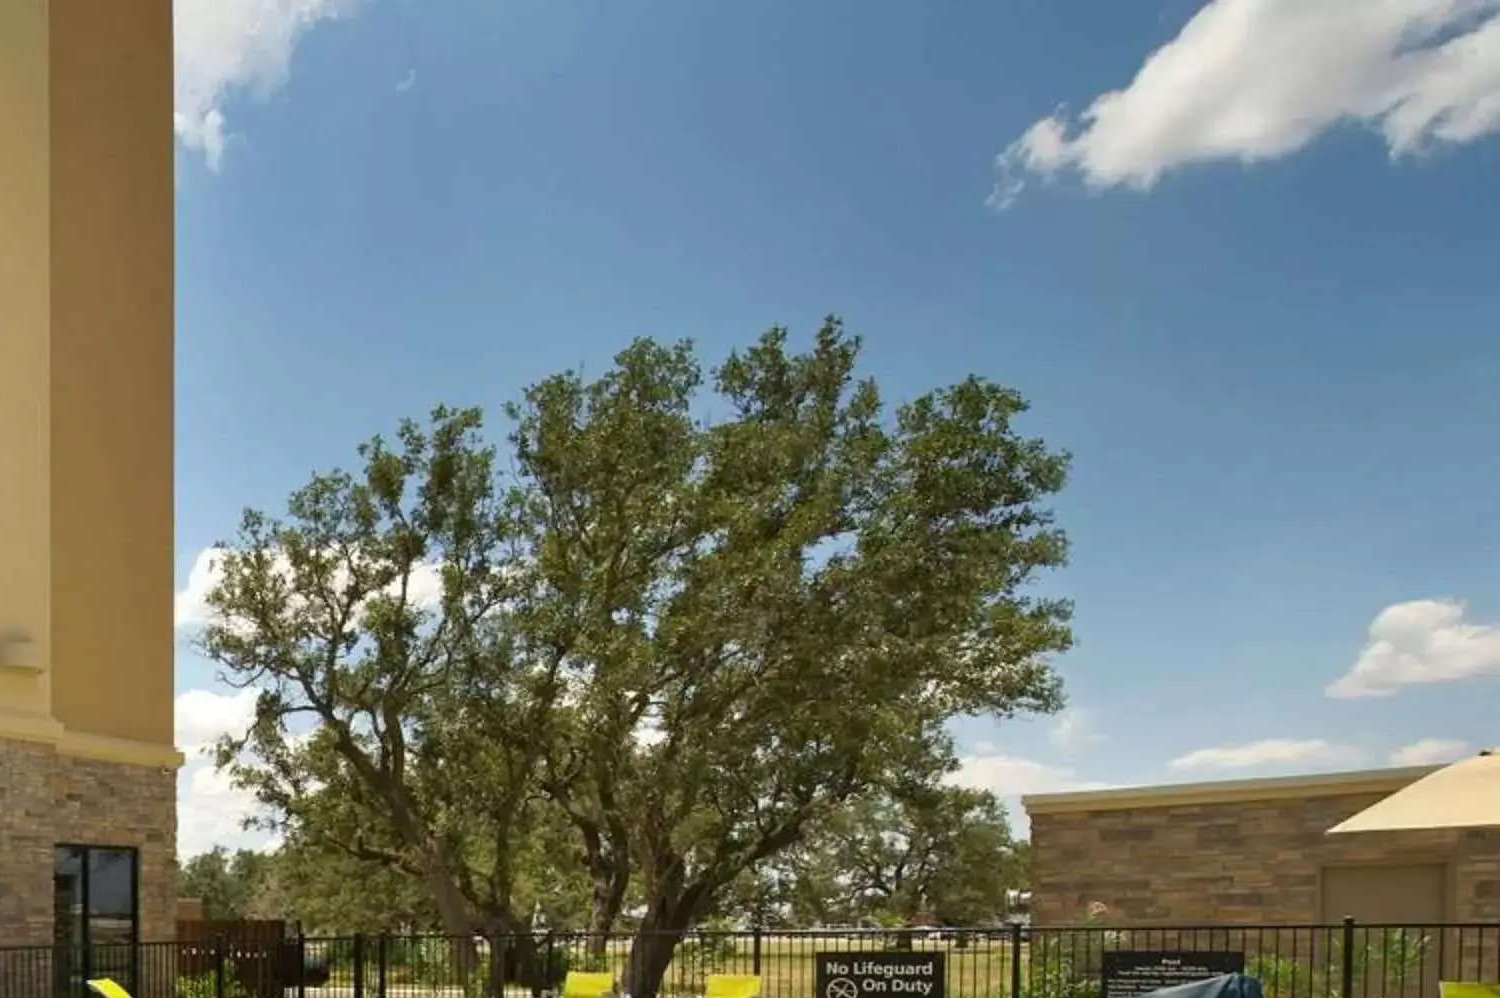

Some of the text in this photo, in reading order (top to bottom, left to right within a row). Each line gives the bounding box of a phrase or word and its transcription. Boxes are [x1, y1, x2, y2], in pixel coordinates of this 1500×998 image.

[826, 961, 933, 978] No Lifeguard
[862, 979, 933, 996] On Duty
